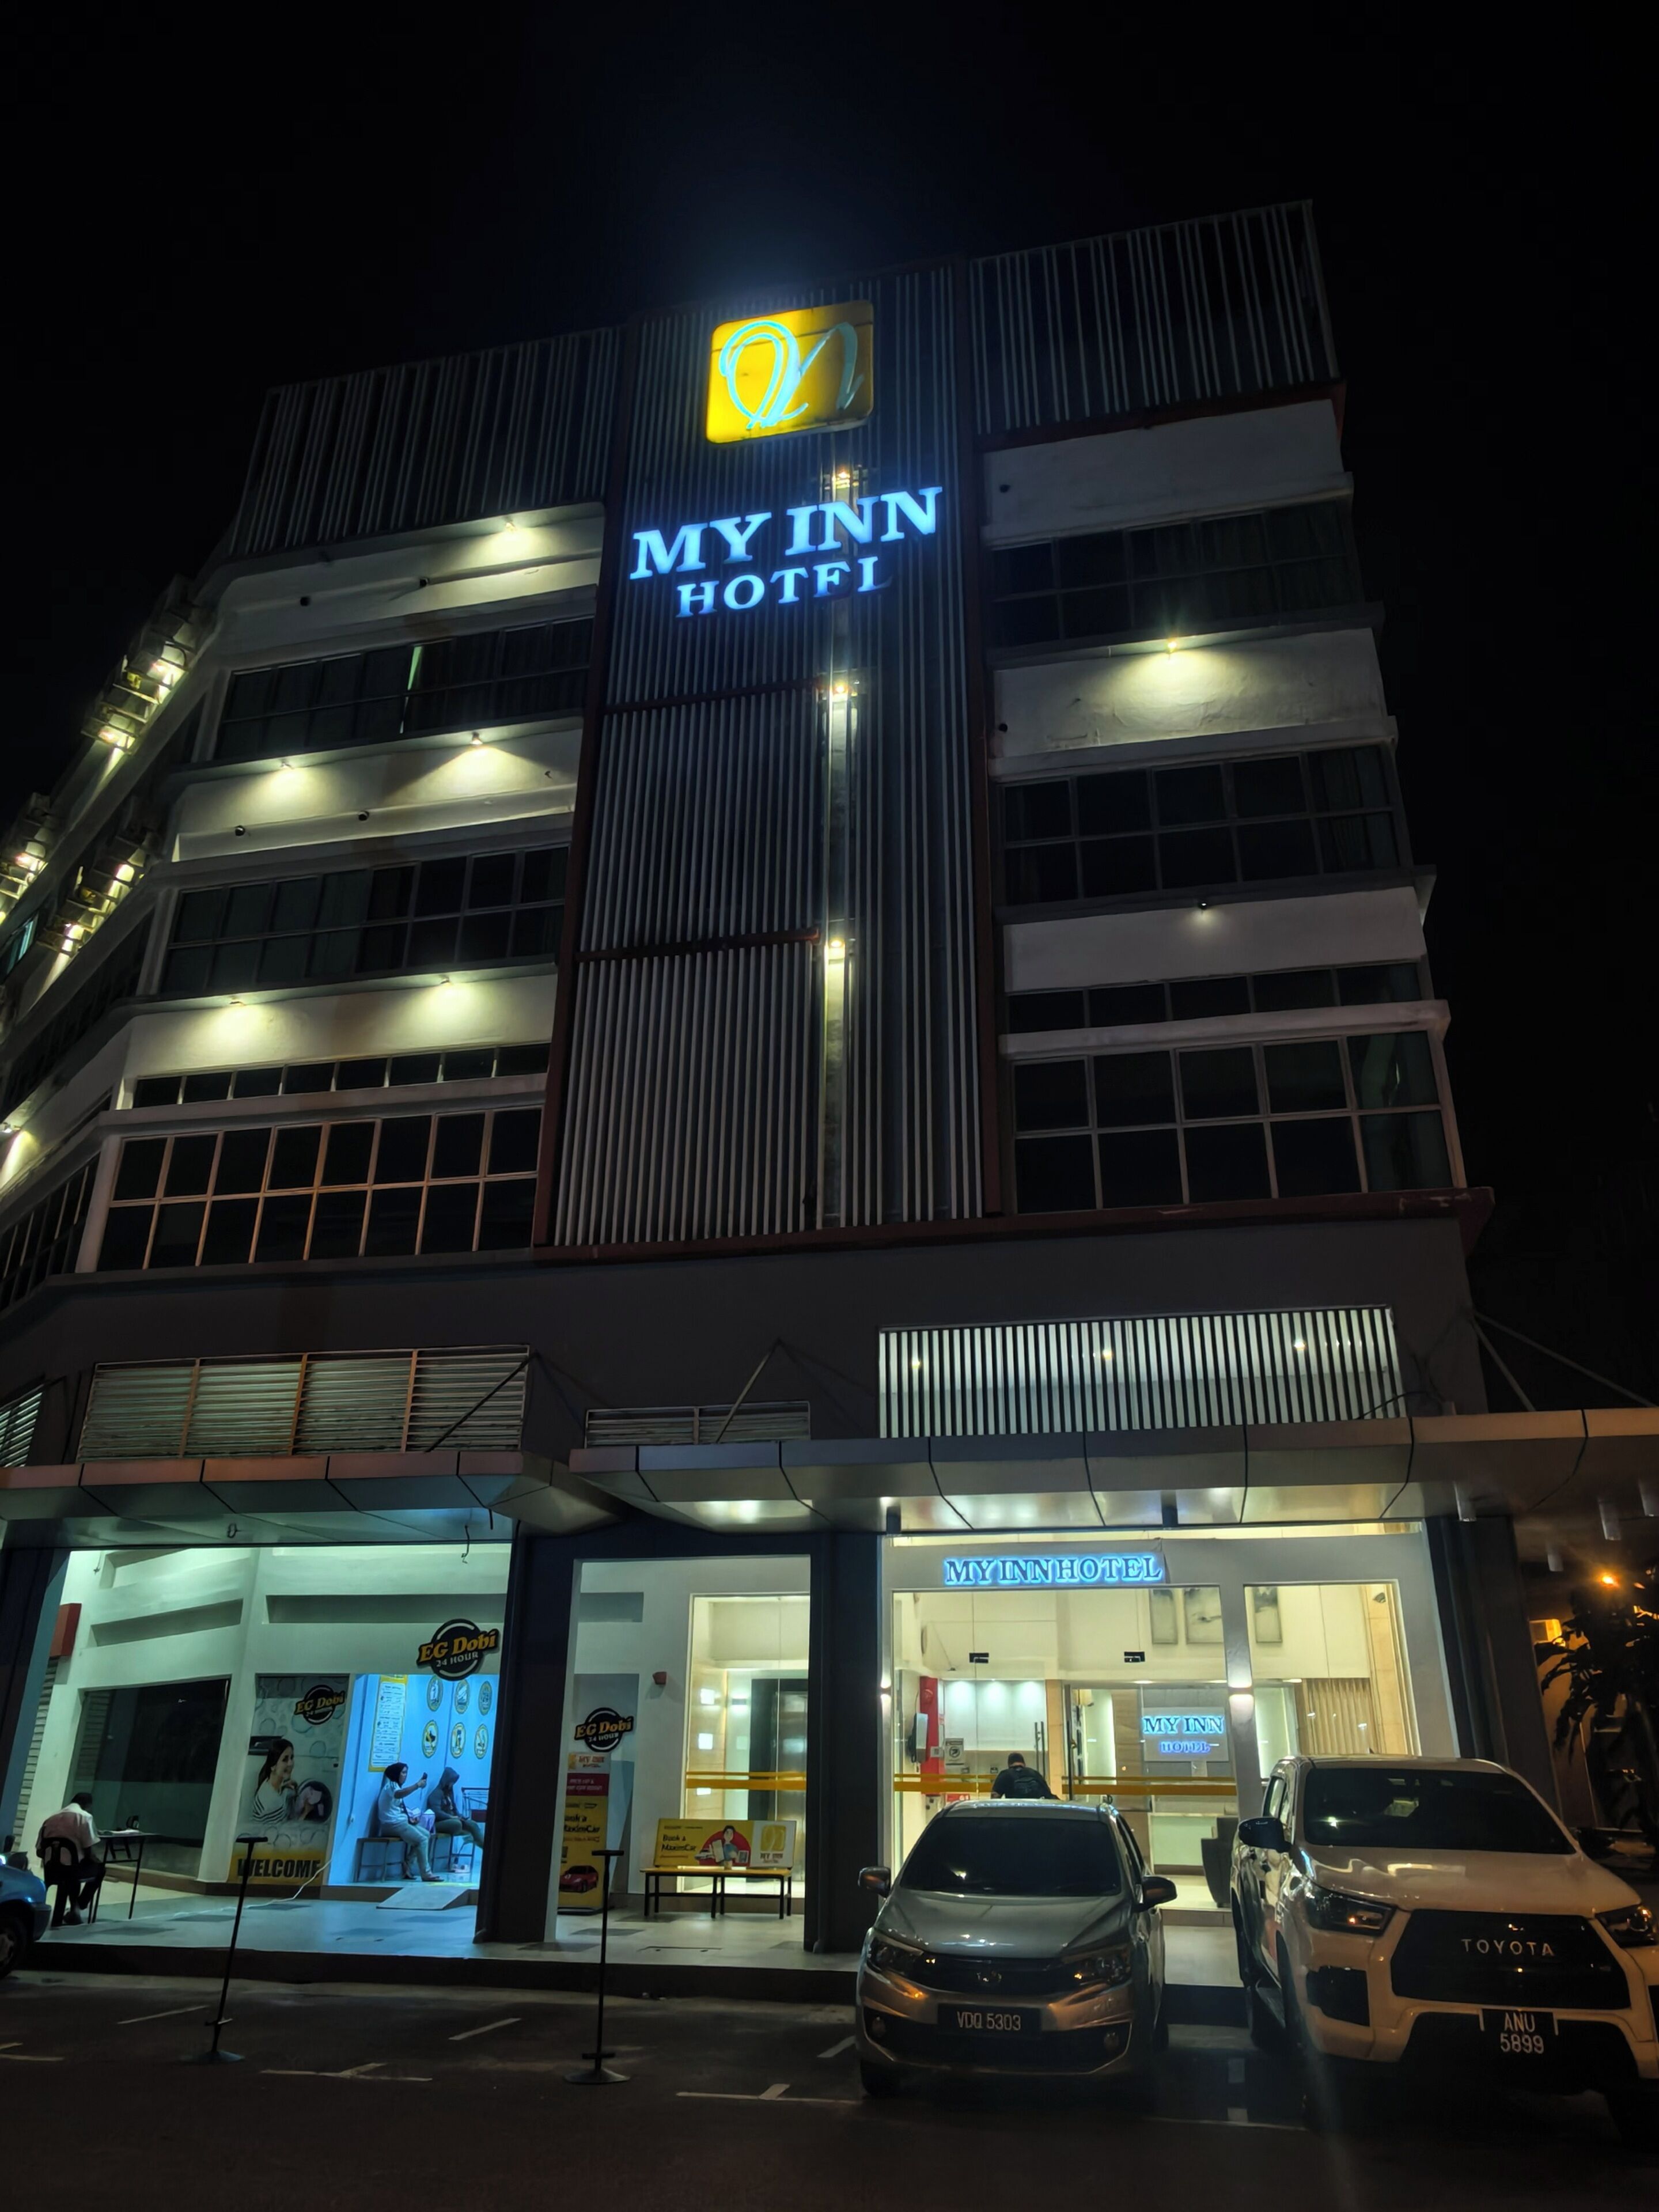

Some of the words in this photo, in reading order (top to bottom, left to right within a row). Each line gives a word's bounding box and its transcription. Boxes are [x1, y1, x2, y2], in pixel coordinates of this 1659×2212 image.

[630, 512, 771, 579] MY
[785, 486, 942, 555] INN
[945, 1559, 995, 1585] MY
[999, 1558, 1053, 1584] INN
[1056, 1555, 1163, 1582] HOTEL
[419, 1641, 449, 1662] EG
[452, 1631, 496, 1655] Dobi
[436, 1658, 447, 1667] 24
[450, 1651, 479, 1664] HOUR
[576, 1724, 597, 1738] EG
[599, 1717, 632, 1734] Dobi
[1142, 1716, 1180, 1734] MY
[1183, 1716, 1224, 1734] INN
[1461, 1939, 1554, 1956] TOYOTA
[957, 2011, 983, 2028] VDQ
[987, 2013, 1021, 2031] 5303
[1504, 2012, 1535, 2032] ANU
[1500, 2033, 1544, 2054] 5899
